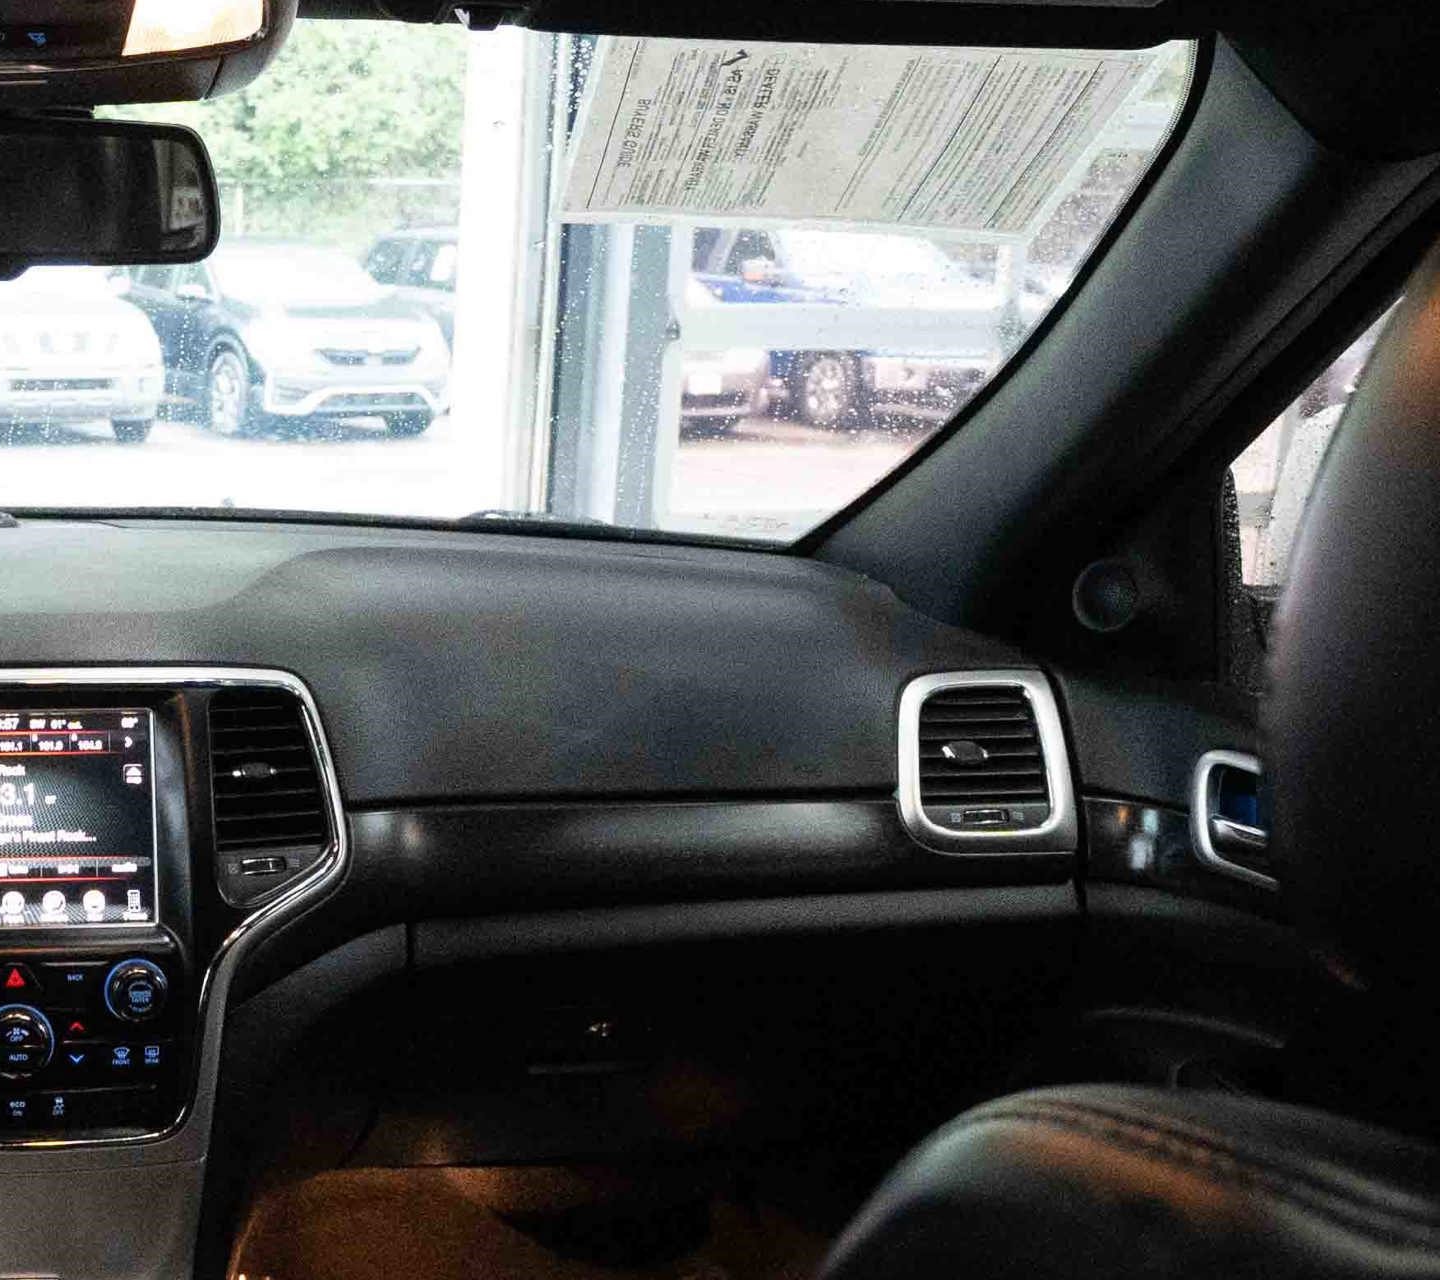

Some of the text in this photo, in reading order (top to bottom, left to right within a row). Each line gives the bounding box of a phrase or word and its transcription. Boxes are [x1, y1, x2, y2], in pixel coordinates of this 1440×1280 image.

[10, 1035, 24, 1043] OFF
[9, 1054, 28, 1062] AUTO
[10, 1100, 26, 1109] eco
